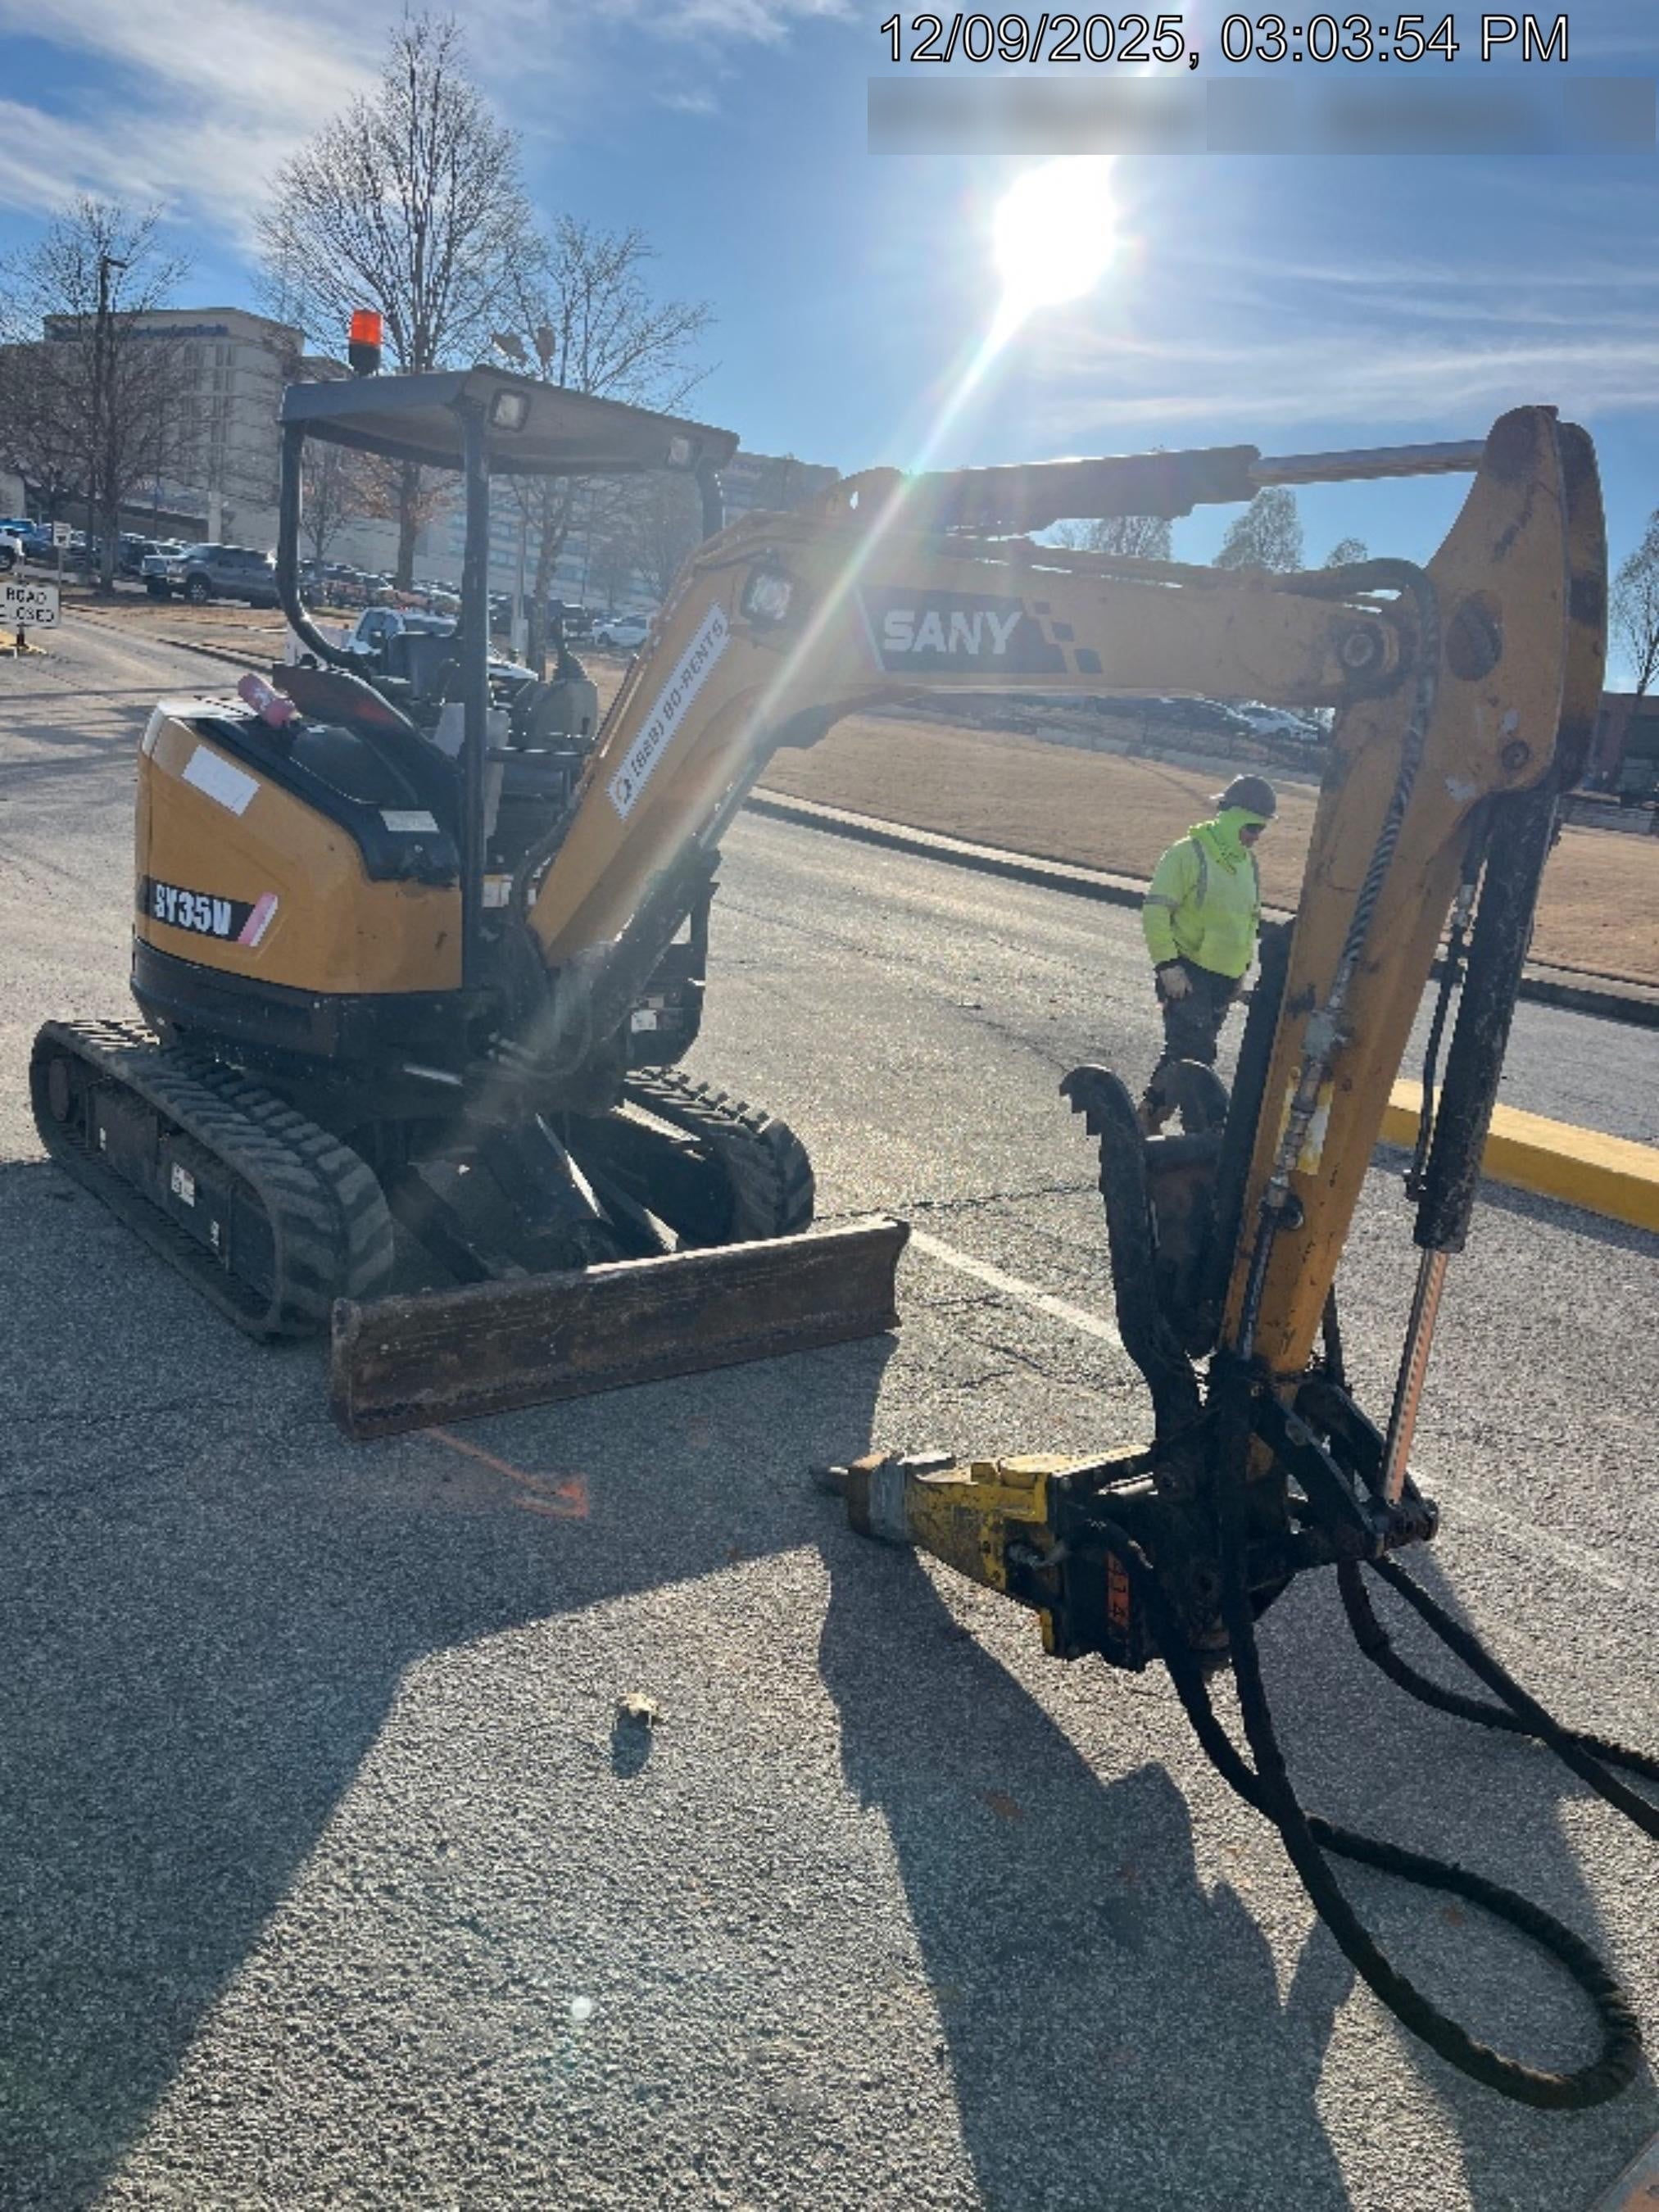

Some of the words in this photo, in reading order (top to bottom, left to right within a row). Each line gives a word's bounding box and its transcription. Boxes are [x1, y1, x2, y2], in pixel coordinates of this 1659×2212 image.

[7, 587, 48, 605] ROAD
[884, 610, 1022, 655] SANY
[155, 883, 232, 936] SY35U
